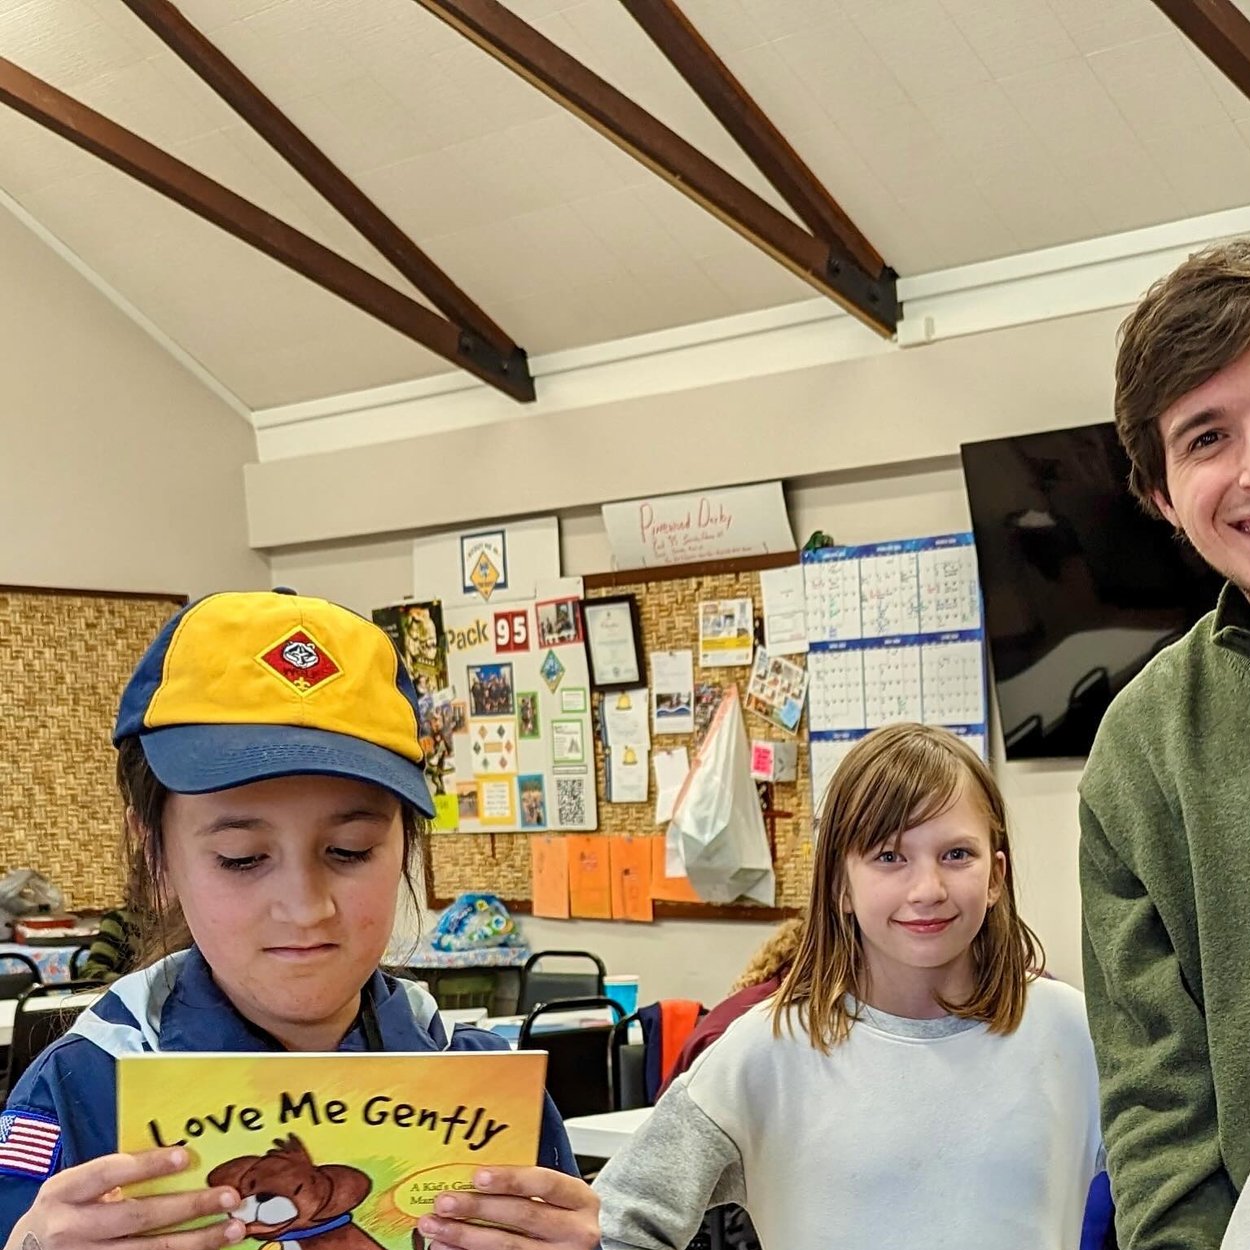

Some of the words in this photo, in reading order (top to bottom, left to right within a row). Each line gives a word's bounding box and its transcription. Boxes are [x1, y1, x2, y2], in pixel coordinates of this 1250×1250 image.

[447, 620, 489, 653] Pack
[496, 615, 527, 646] 95
[148, 1104, 264, 1148] Love
[279, 1091, 348, 1125] Me
[363, 1096, 509, 1151] Gently
[410, 1183, 420, 1192] A
